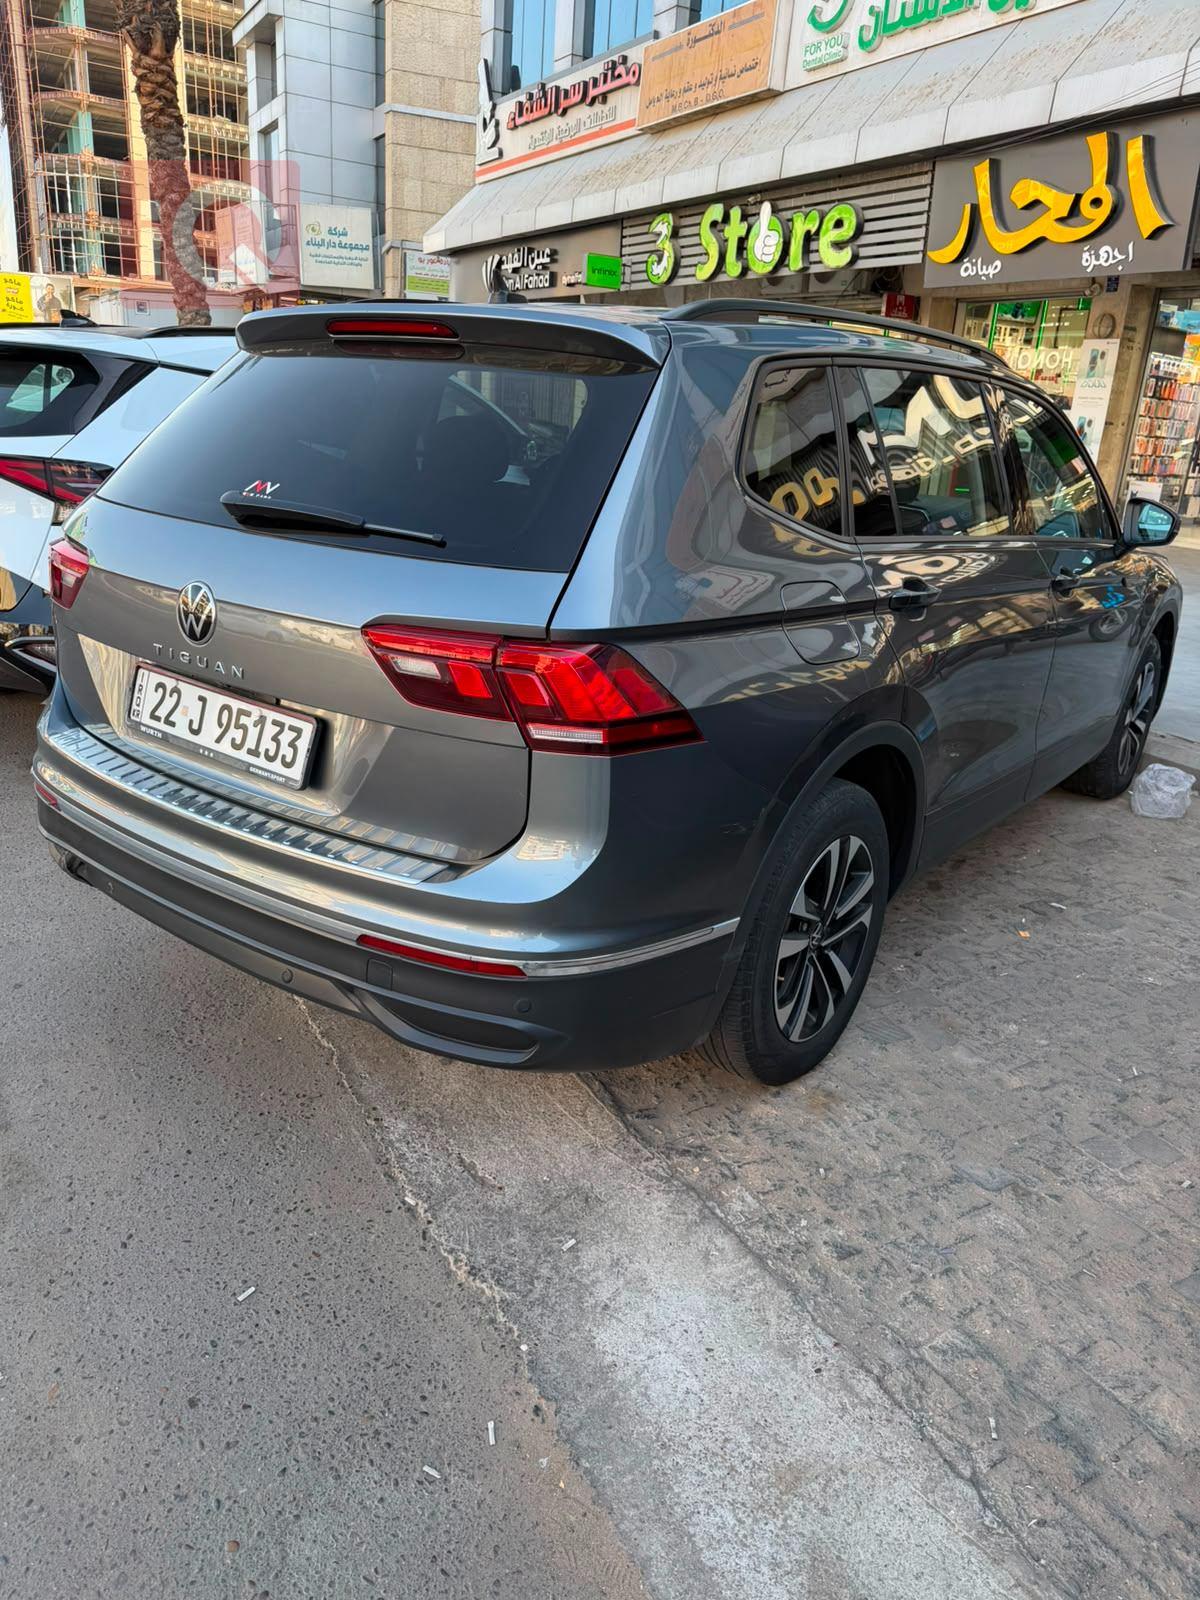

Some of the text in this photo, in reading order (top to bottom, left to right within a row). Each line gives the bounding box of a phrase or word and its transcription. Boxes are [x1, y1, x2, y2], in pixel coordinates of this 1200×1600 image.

[686, 19, 726, 49] الدكتورة
[803, 34, 843, 58] FOR YOU
[802, 49, 842, 69] Dental Clinic
[507, 54, 642, 131] مختبر سر الشفاء
[926, 131, 1171, 266] المحار
[327, 225, 349, 237] شركة
[306, 237, 370, 252] مجموعة دار البناء
[646, 202, 858, 287] 3 Store
[501, 247, 551, 273] عين الفهد
[959, 255, 1003, 281] صيانة
[515, 274, 524, 291] Al
[524, 271, 550, 289] Fahad
[153, 643, 245, 680] TIGUAN
[149, 681, 304, 769] 22 J 95133
